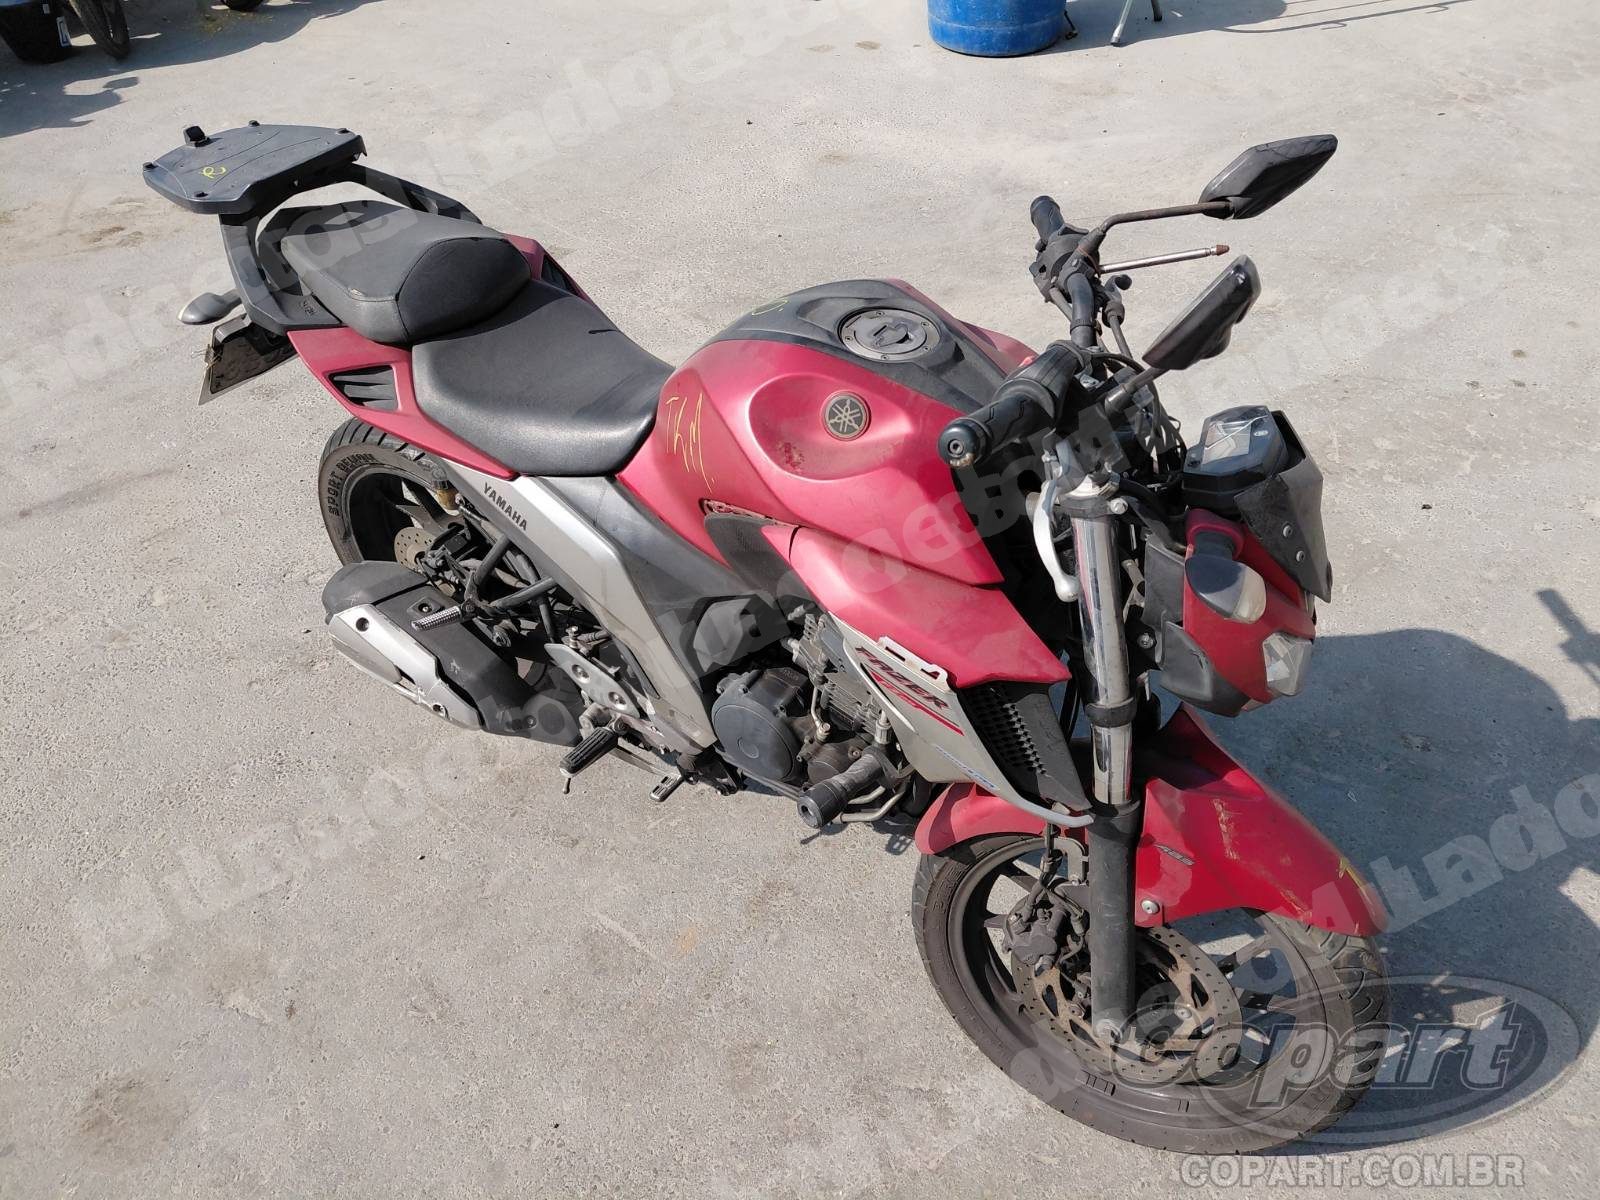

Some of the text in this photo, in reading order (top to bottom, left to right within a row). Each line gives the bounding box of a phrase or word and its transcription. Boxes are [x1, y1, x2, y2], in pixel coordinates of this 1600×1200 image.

[326, 470, 345, 517] SPORT
[483, 482, 528, 531] YAMAHA
[855, 647, 949, 710] FAZER
